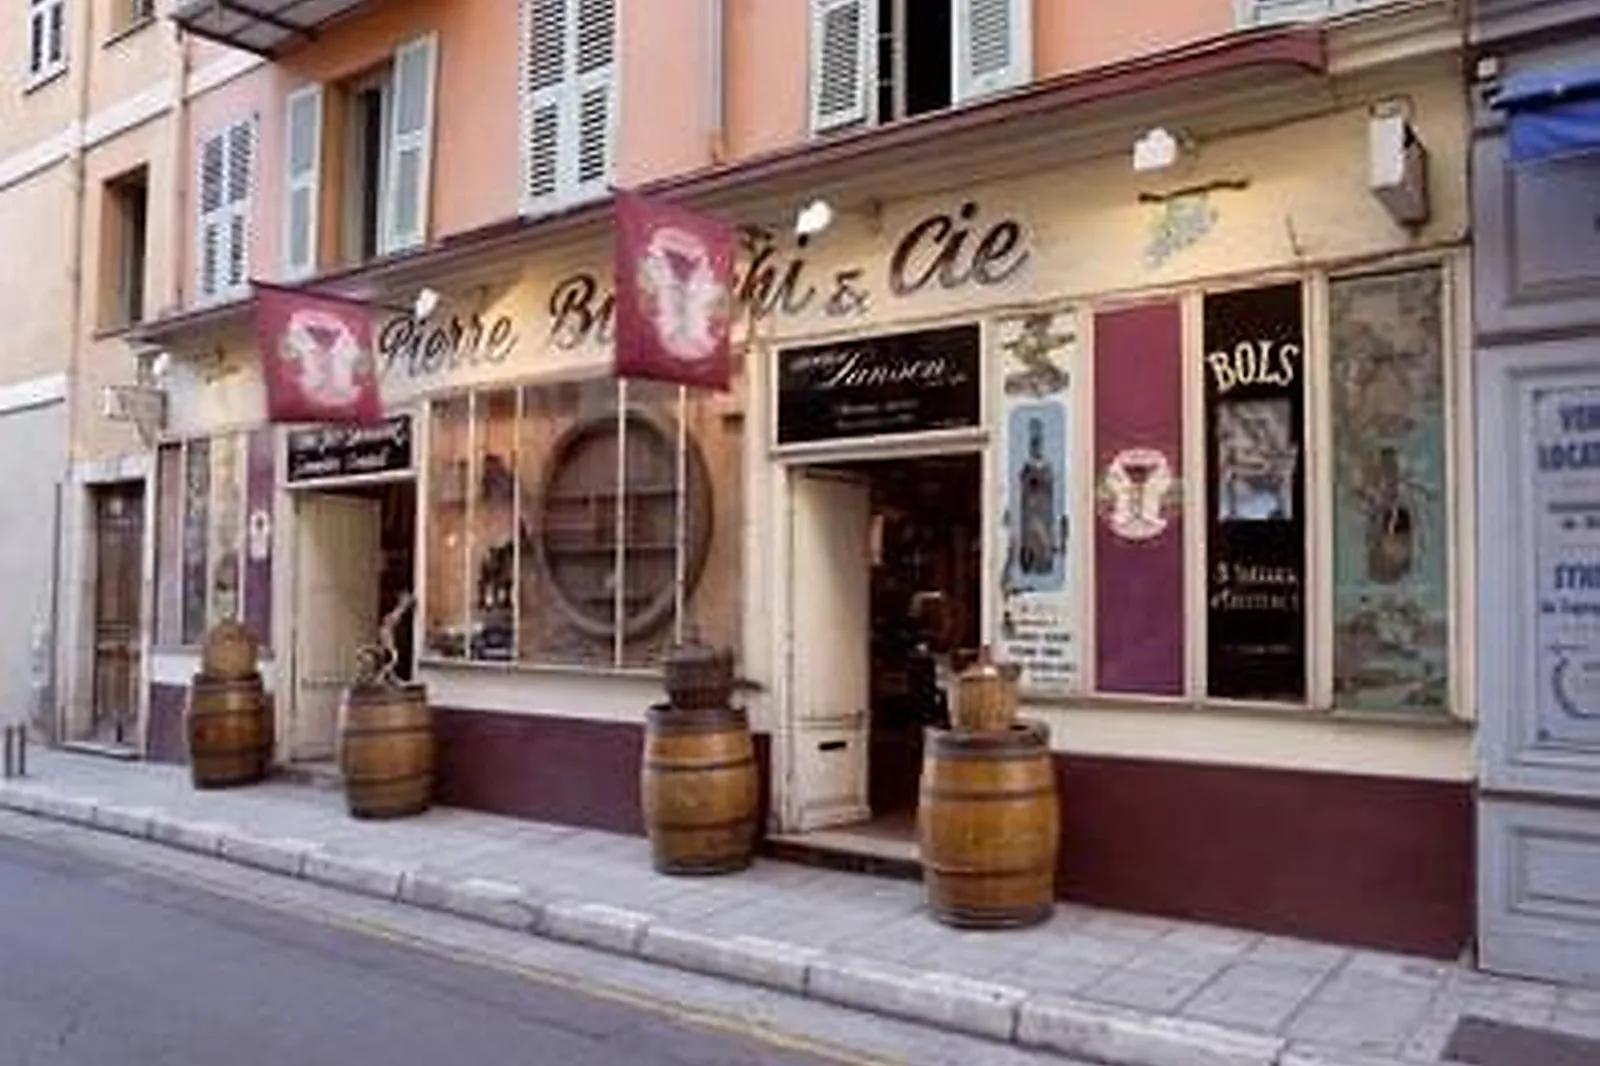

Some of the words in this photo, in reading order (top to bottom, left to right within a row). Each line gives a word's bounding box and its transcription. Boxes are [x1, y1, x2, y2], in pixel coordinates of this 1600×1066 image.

[379, 311, 518, 378] Pierre
[826, 268, 868, 317] &
[889, 201, 1031, 297] Cie
[1206, 340, 1299, 393] BOLS
